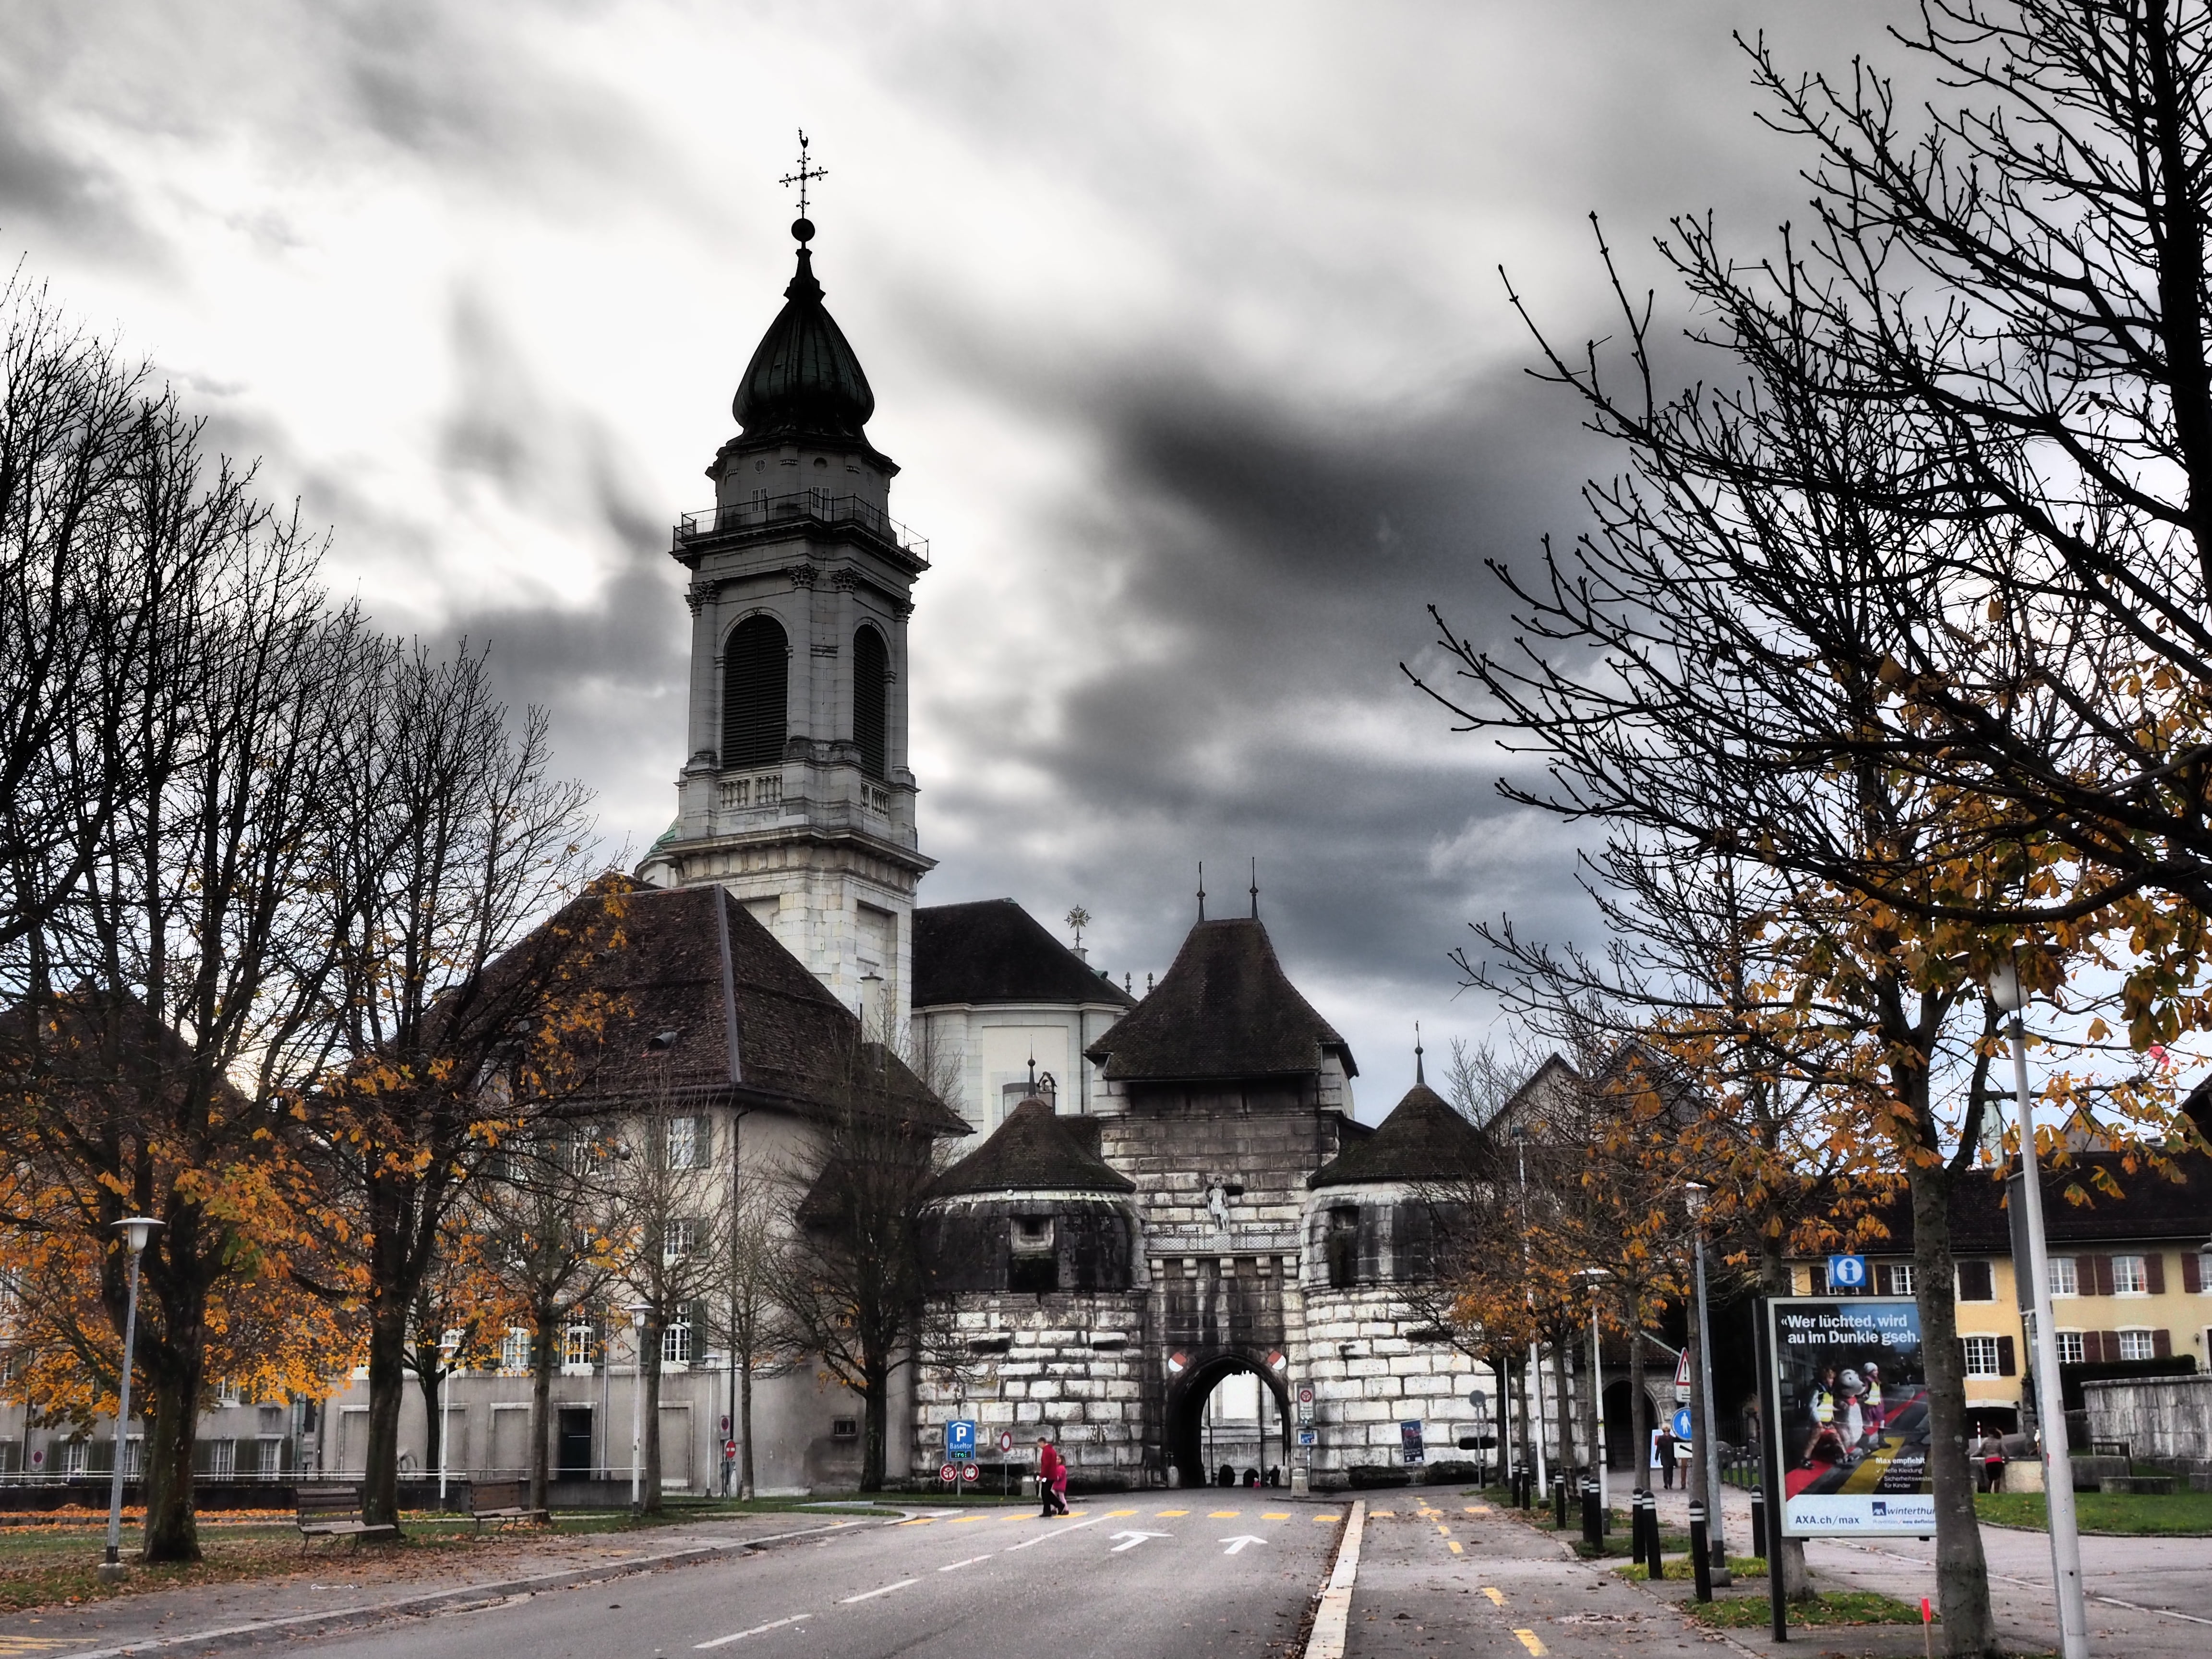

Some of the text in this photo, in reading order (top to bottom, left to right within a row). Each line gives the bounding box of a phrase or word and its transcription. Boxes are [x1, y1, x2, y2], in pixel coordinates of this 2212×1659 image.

[1781, 1314, 1907, 1329] «Wer lüchted, wird
[1788, 1330, 1921, 1346] au im Dunkle gseh.
[956, 1427, 966, 1442] P
[1892, 1457, 1925, 1465] empfiehlt
[1795, 1515, 1860, 1526] AXA.ch/max
